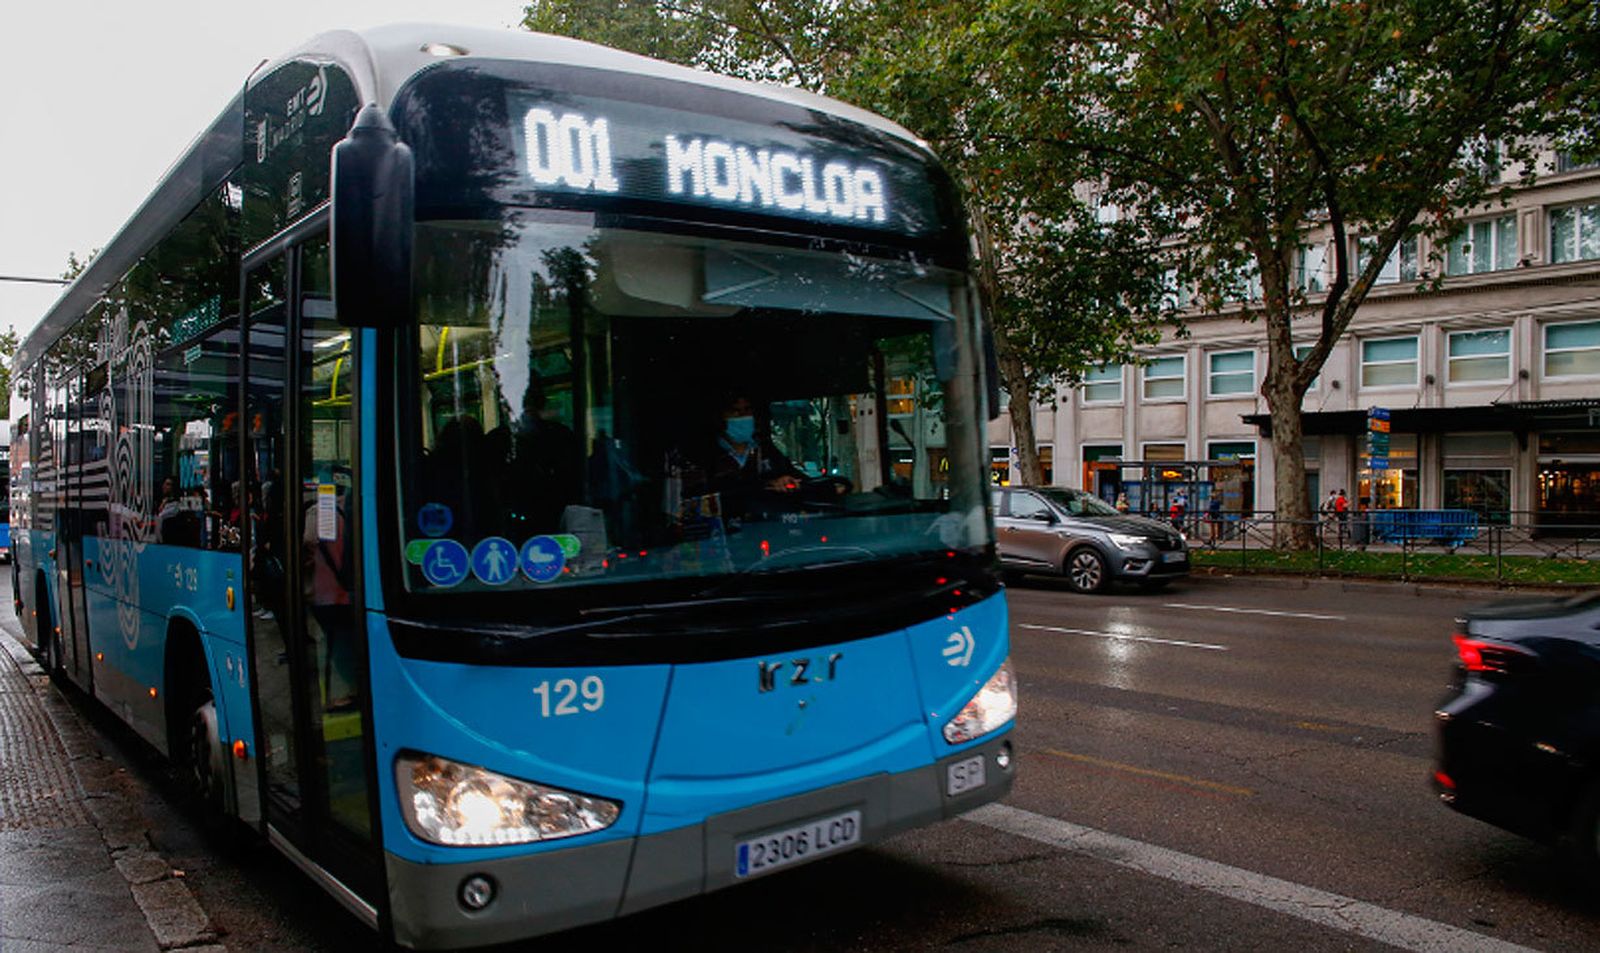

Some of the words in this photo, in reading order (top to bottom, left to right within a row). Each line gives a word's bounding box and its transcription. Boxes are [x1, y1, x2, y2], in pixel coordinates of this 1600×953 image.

[525, 107, 619, 192] 001
[665, 135, 887, 222] MONCLOA
[532, 675, 605, 717] 129
[952, 760, 980, 790] SP
[752, 831, 808, 868] 2306
[815, 817, 855, 849] LCD
